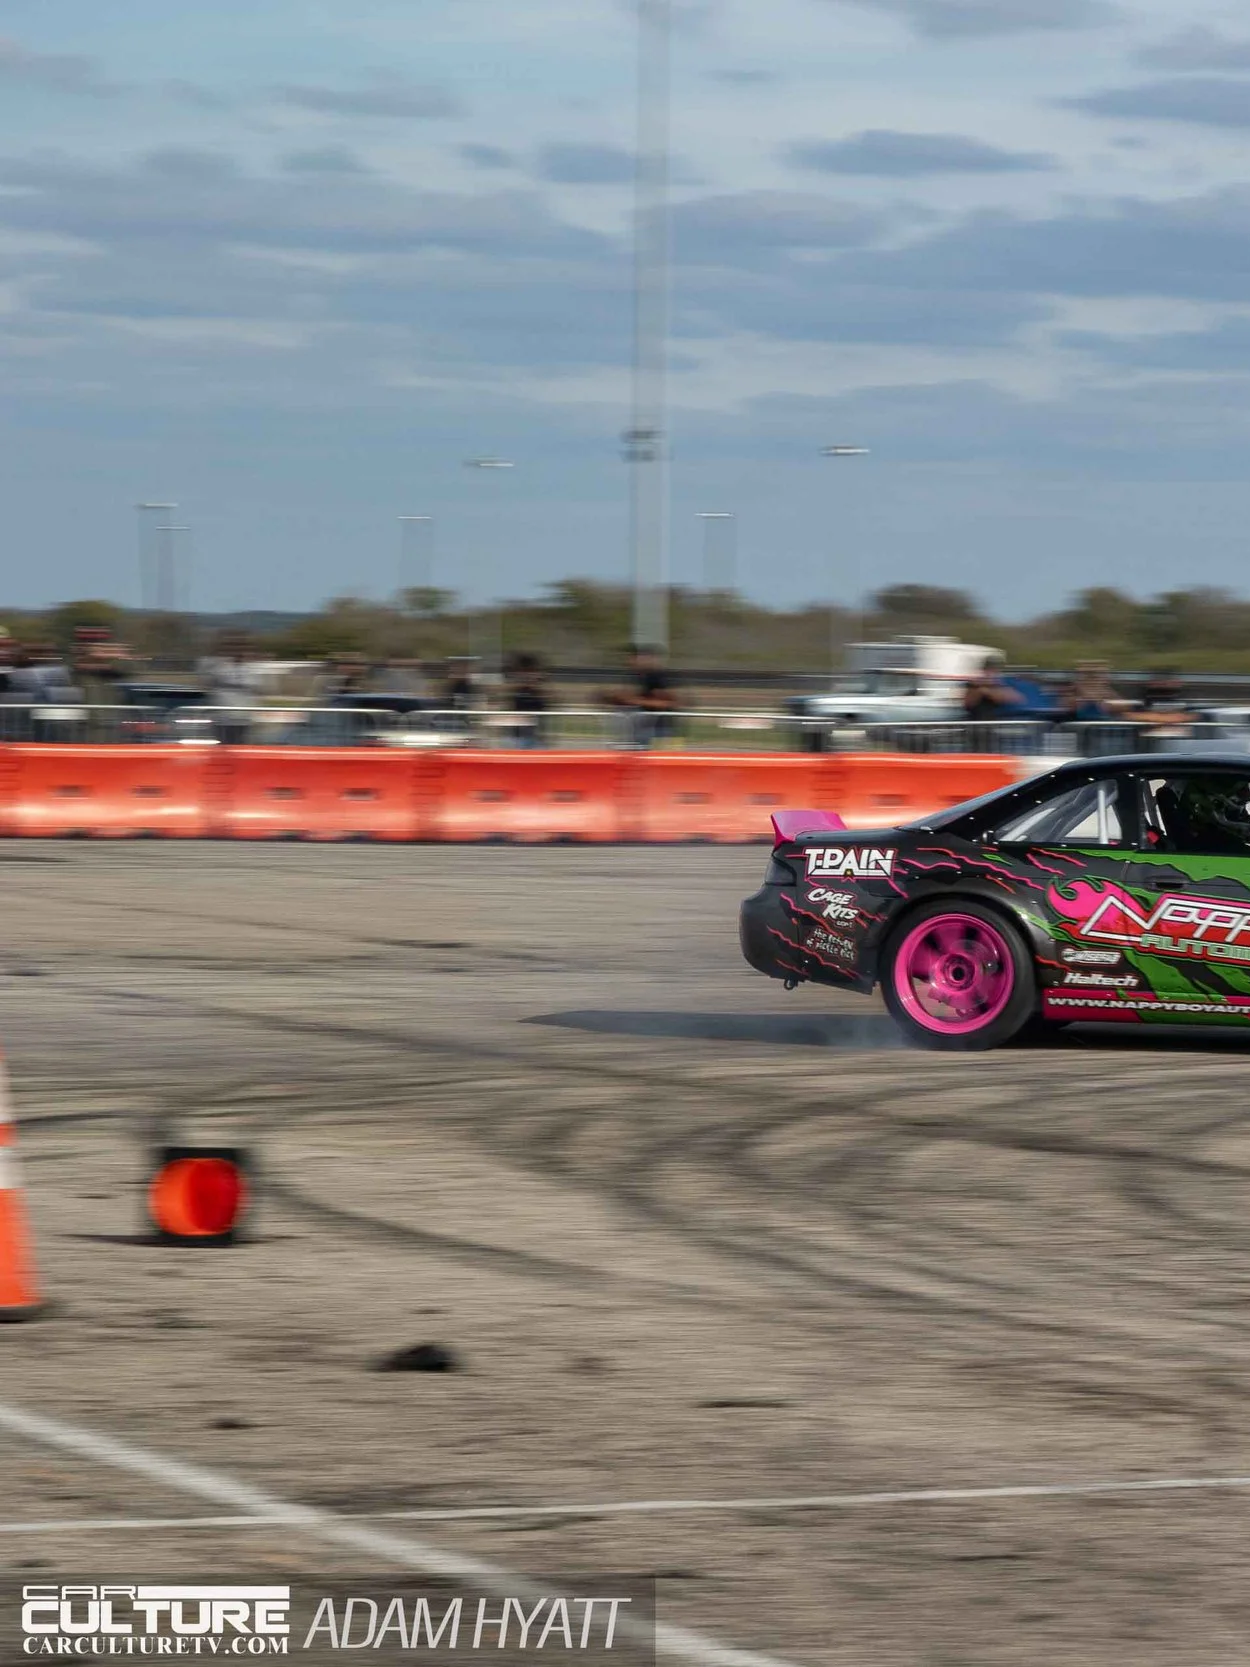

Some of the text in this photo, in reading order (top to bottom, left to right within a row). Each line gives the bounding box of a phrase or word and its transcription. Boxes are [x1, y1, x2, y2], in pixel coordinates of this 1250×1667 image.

[808, 888, 854, 905] CAGE
[822, 903, 858, 919] KITS
[1064, 972, 1139, 987] Haltech
